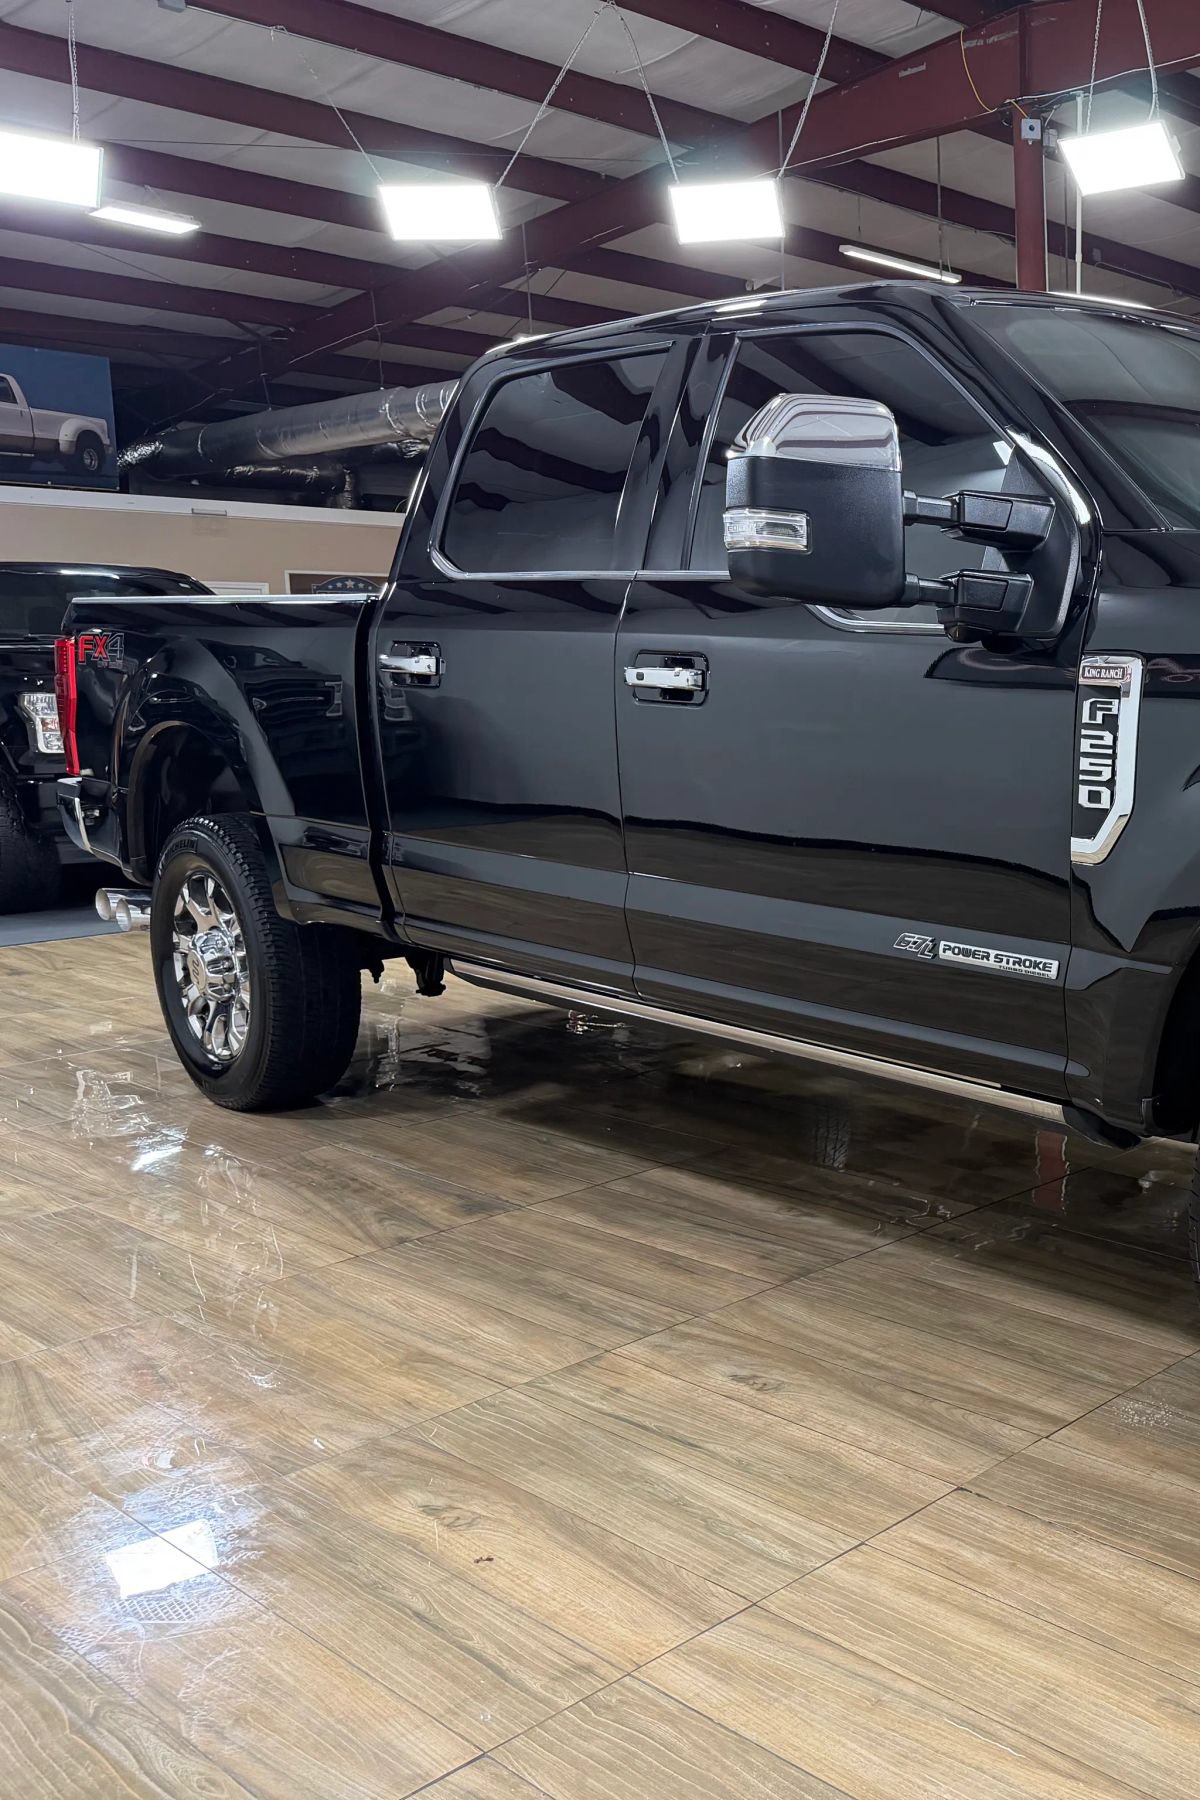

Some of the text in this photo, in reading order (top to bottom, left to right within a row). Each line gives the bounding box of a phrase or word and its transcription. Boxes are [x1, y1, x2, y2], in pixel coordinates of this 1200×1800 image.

[78, 632, 125, 665] FX4
[1084, 666, 1124, 680] KING RANCH
[1078, 698, 1119, 809] F250
[942, 943, 1054, 974] POWER STROKE
